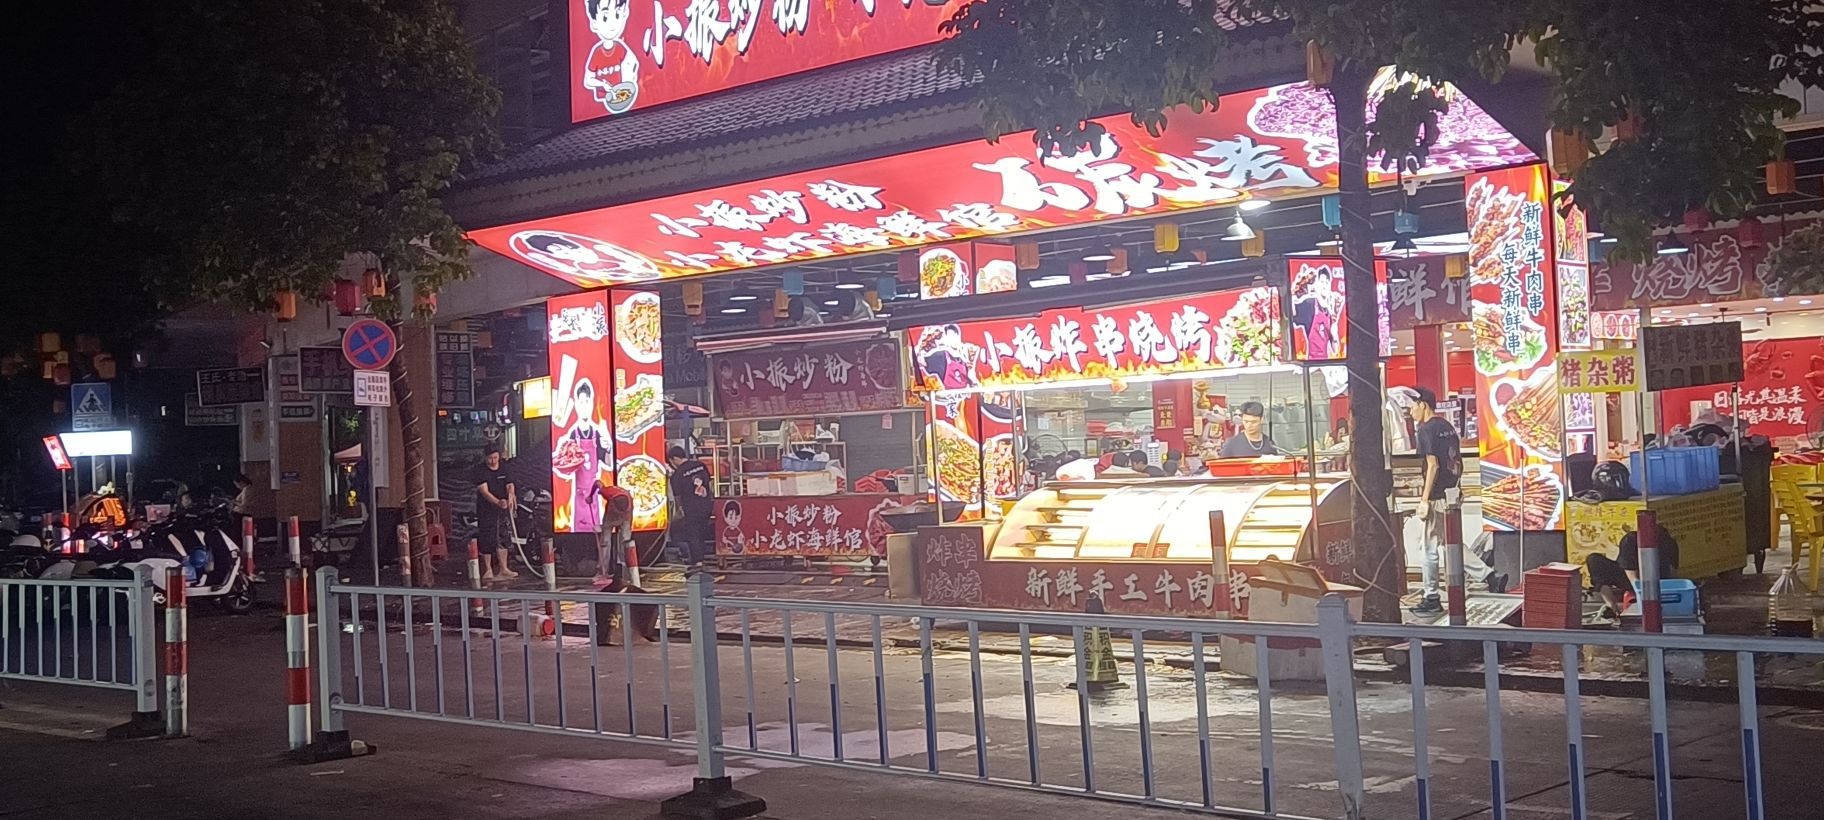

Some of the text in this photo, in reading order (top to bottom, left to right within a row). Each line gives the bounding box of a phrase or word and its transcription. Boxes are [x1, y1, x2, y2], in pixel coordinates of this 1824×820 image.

[650, 179, 885, 238] 小振炒粉
[1522, 203, 1544, 314] 新鲜牛肉串
[1502, 243, 1522, 353] 每天新鲜串
[980, 304, 1214, 375] 小振炸串烧烤
[740, 353, 854, 393] 小振炒粉
[1560, 355, 1636, 388] 猪杂粥
[767, 504, 842, 527] 小振炒粉
[926, 535, 977, 569] 炸串
[923, 569, 982, 604] 烧烤
[1025, 566, 1251, 611] 新鲜手工牛肉串
